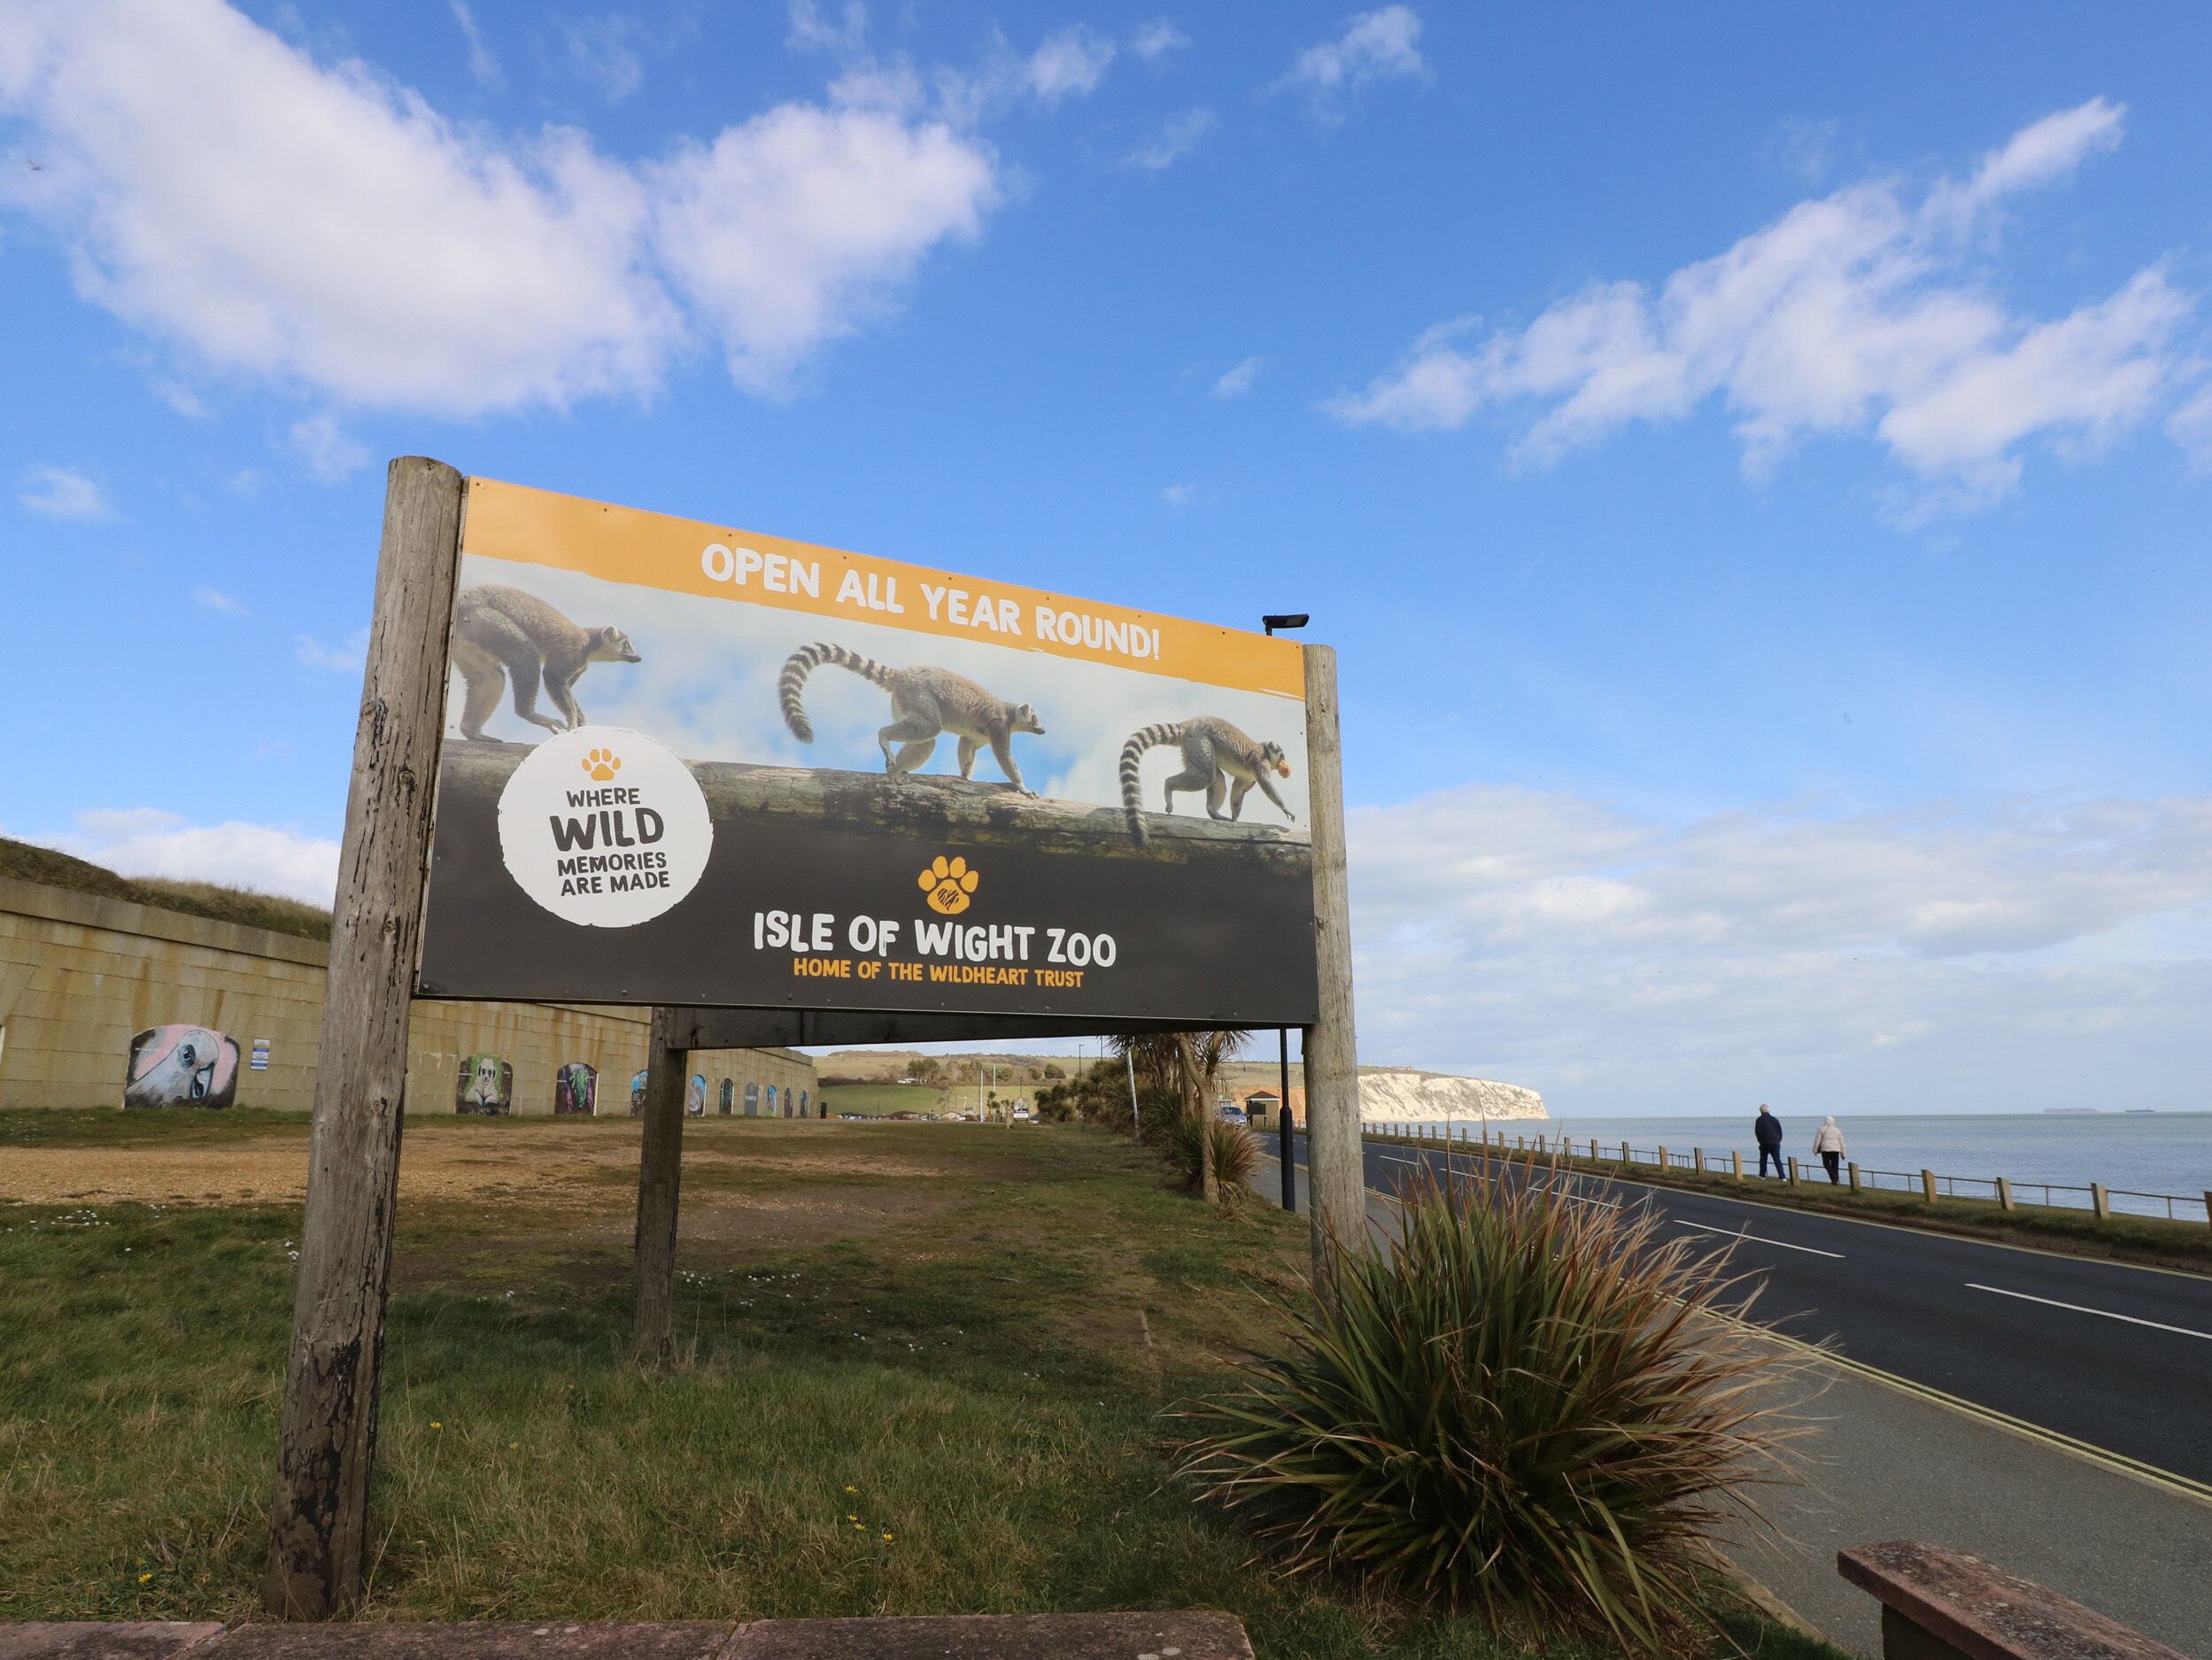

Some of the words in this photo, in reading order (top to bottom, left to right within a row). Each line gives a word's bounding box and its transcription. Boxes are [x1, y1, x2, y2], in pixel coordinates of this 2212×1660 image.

[700, 543, 820, 598] OPEN
[835, 568, 905, 614] ALL
[920, 583, 1022, 636] YEAR
[1035, 606, 1160, 660] ROUND!
[566, 787, 641, 808] WHERE
[549, 807, 664, 852] WILD
[557, 852, 667, 877] MEMORIES
[561, 876, 603, 897] ARE
[609, 870, 670, 893] MADE
[754, 909, 835, 953] ISLE
[848, 915, 900, 957] OF
[914, 919, 1036, 962] WIGHT
[1046, 928, 1117, 968] ZOO
[793, 957, 852, 978] HOME
[857, 960, 882, 979] OF
[888, 961, 924, 982] THE
[929, 964, 1029, 985] WILDHEART
[1034, 969, 1085, 988] TRUST
